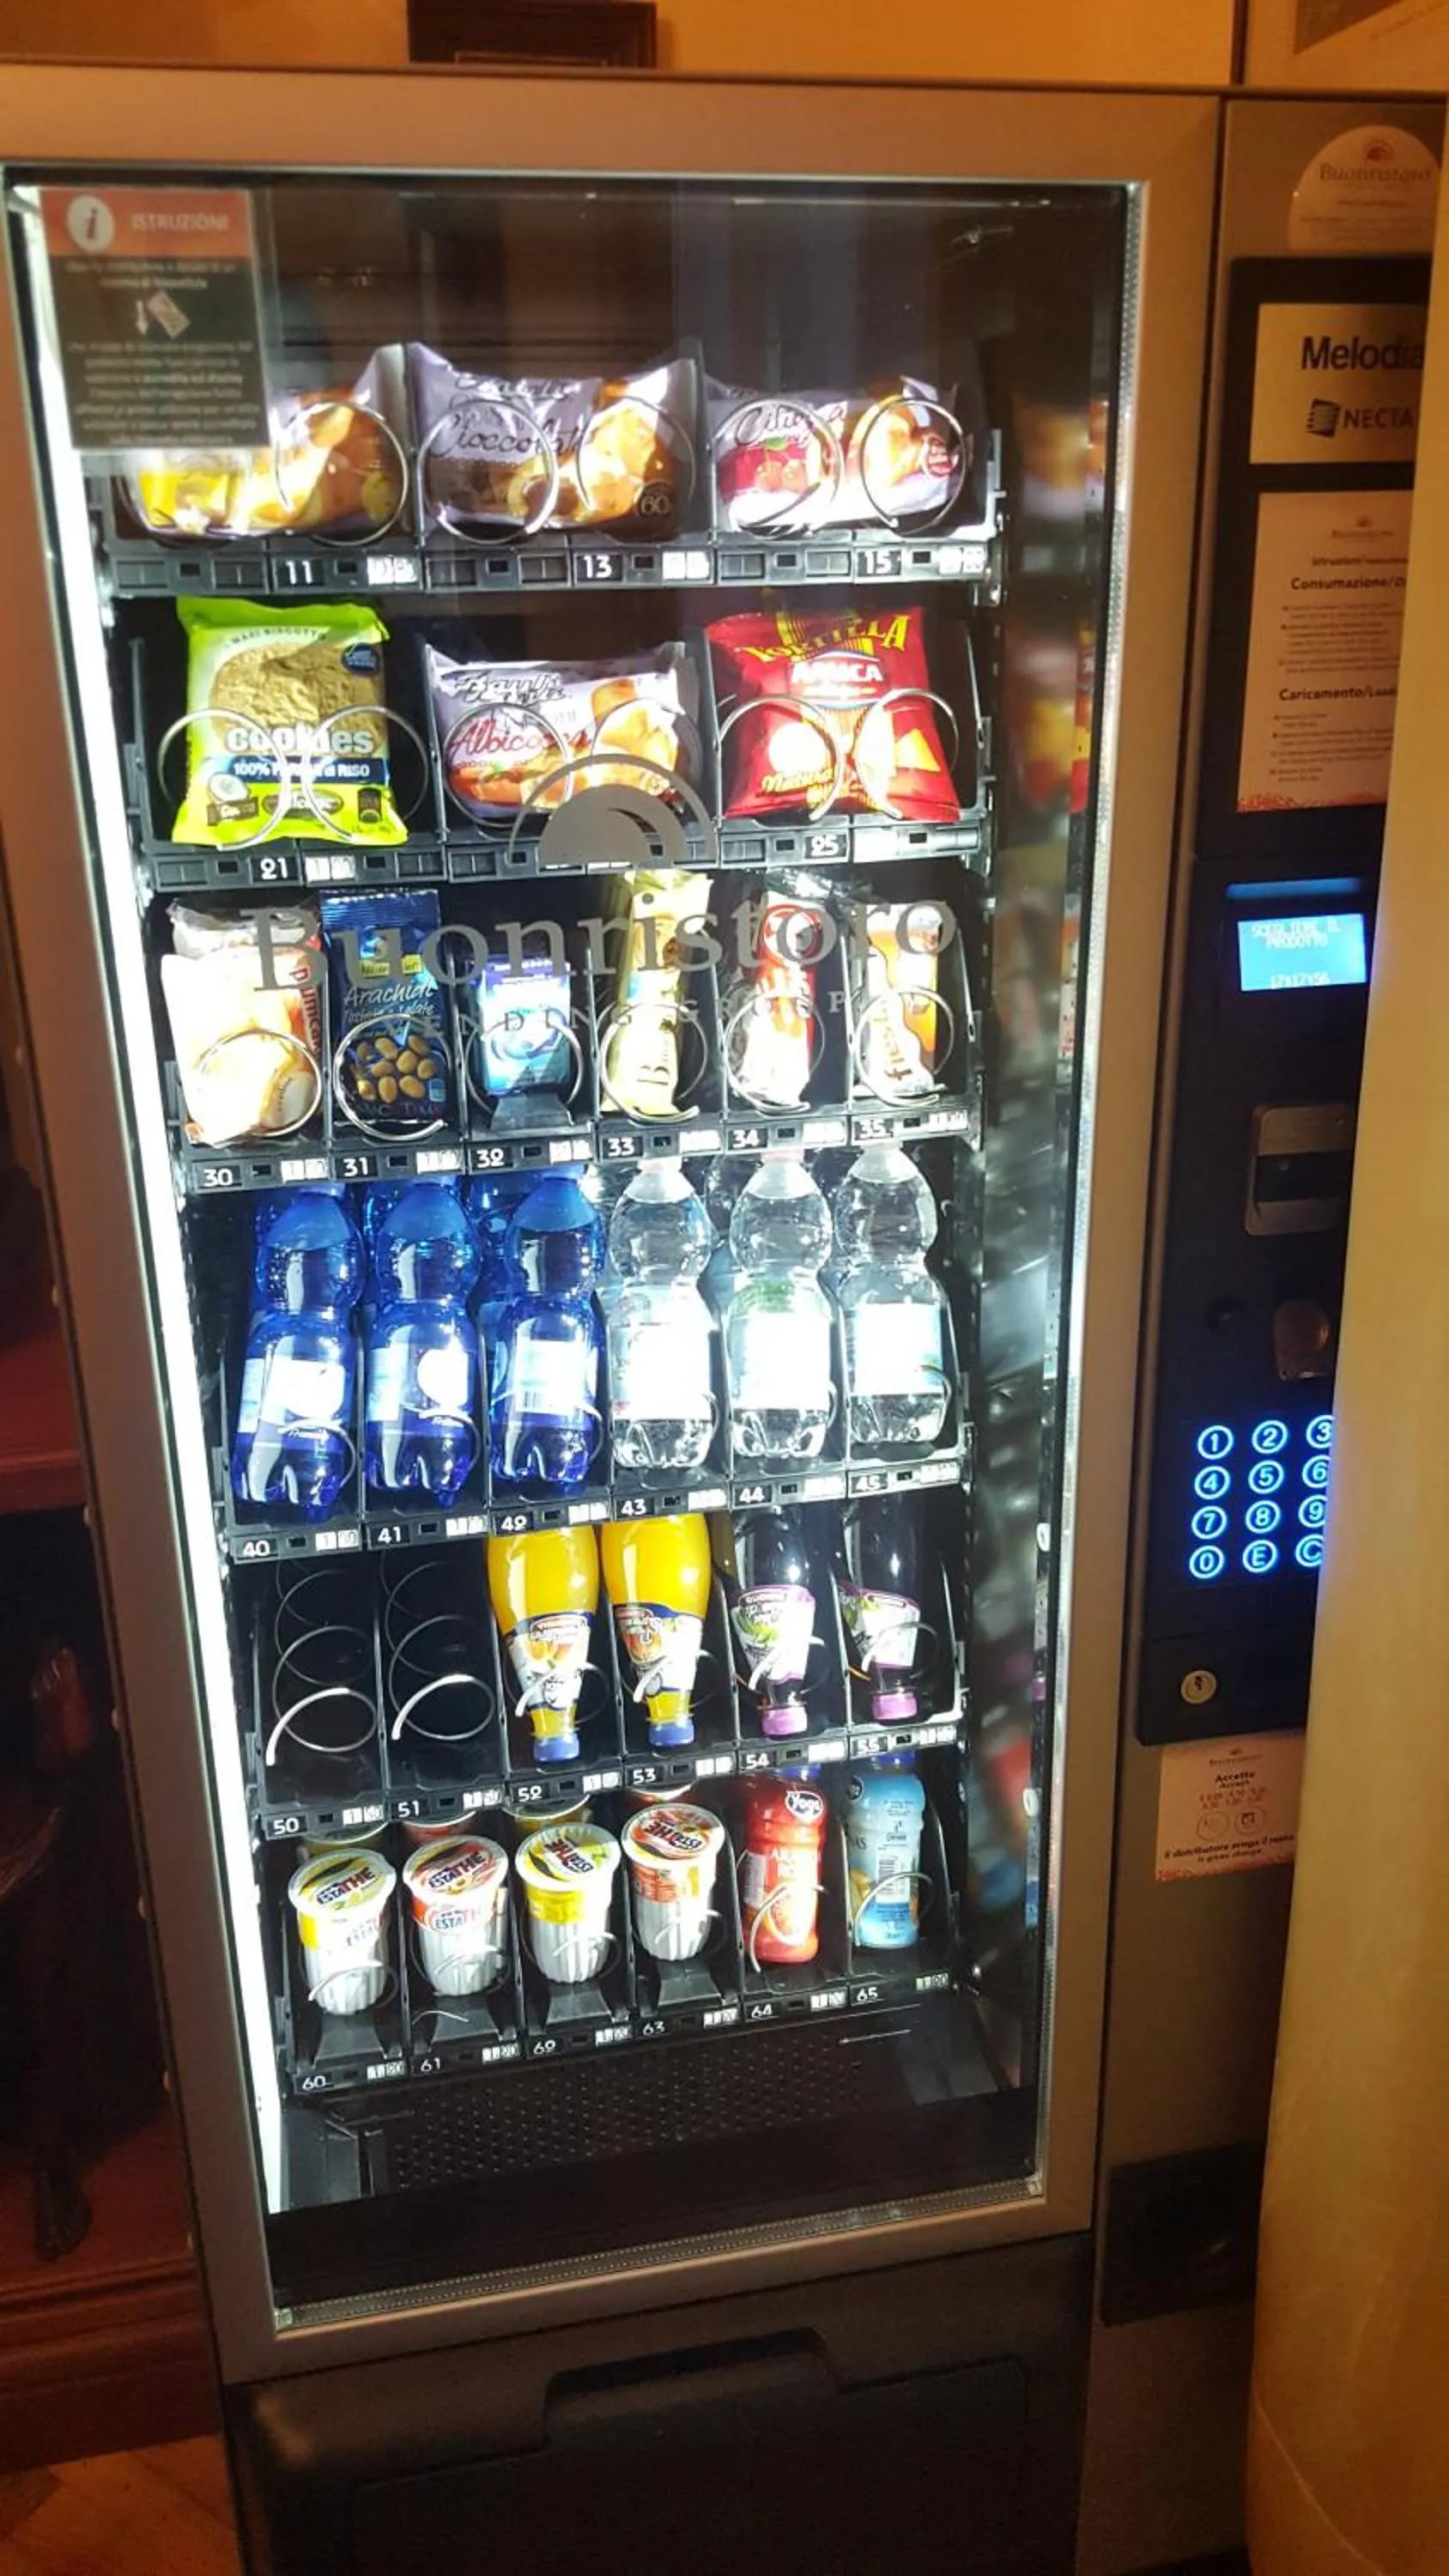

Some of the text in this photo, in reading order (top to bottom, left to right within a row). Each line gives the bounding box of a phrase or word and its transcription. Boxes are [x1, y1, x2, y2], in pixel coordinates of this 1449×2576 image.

[131, 212, 228, 232] ISTRUZIONI
[1343, 407, 1413, 428] NECTA
[583, 555, 613, 579] 13
[864, 551, 894, 575] 15
[280, 561, 312, 584] 11
[338, 764, 371, 777] RISO
[809, 835, 840, 856] 25
[259, 858, 288, 880] 21
[240, 893, 957, 993] Buonristoro
[858, 1120, 888, 1138] 35
[607, 1138, 635, 1157] 33
[732, 1129, 761, 1148] 34
[343, 1157, 369, 1176] 31
[476, 1148, 505, 1167] 32
[203, 1168, 233, 1188] 30
[1210, 1421, 1331, 1452] 1 2 3
[855, 1476, 881, 1492] 45
[1203, 1462, 1327, 1492] 4 5 6
[739, 1487, 765, 1504] 44
[621, 1500, 646, 1516] 43
[1203, 1502, 1323, 1532] 7 8 9
[500, 1516, 527, 1531] 42
[378, 1526, 402, 1543] 41
[243, 1541, 271, 1557] 40
[1199, 1541, 1322, 1571] 0 E C
[859, 1737, 882, 1753] 55
[746, 1753, 769, 1770] 54
[633, 1768, 657, 1784] 53
[518, 1785, 543, 1802] 52
[397, 1801, 421, 1818] 51
[272, 1817, 300, 1835] 50
[857, 1986, 879, 2002] 65
[751, 2003, 773, 2019] 64
[643, 2020, 665, 2036] 63
[533, 2039, 556, 2055] 62
[420, 2057, 441, 2073] 61
[301, 2074, 326, 2090] 60
